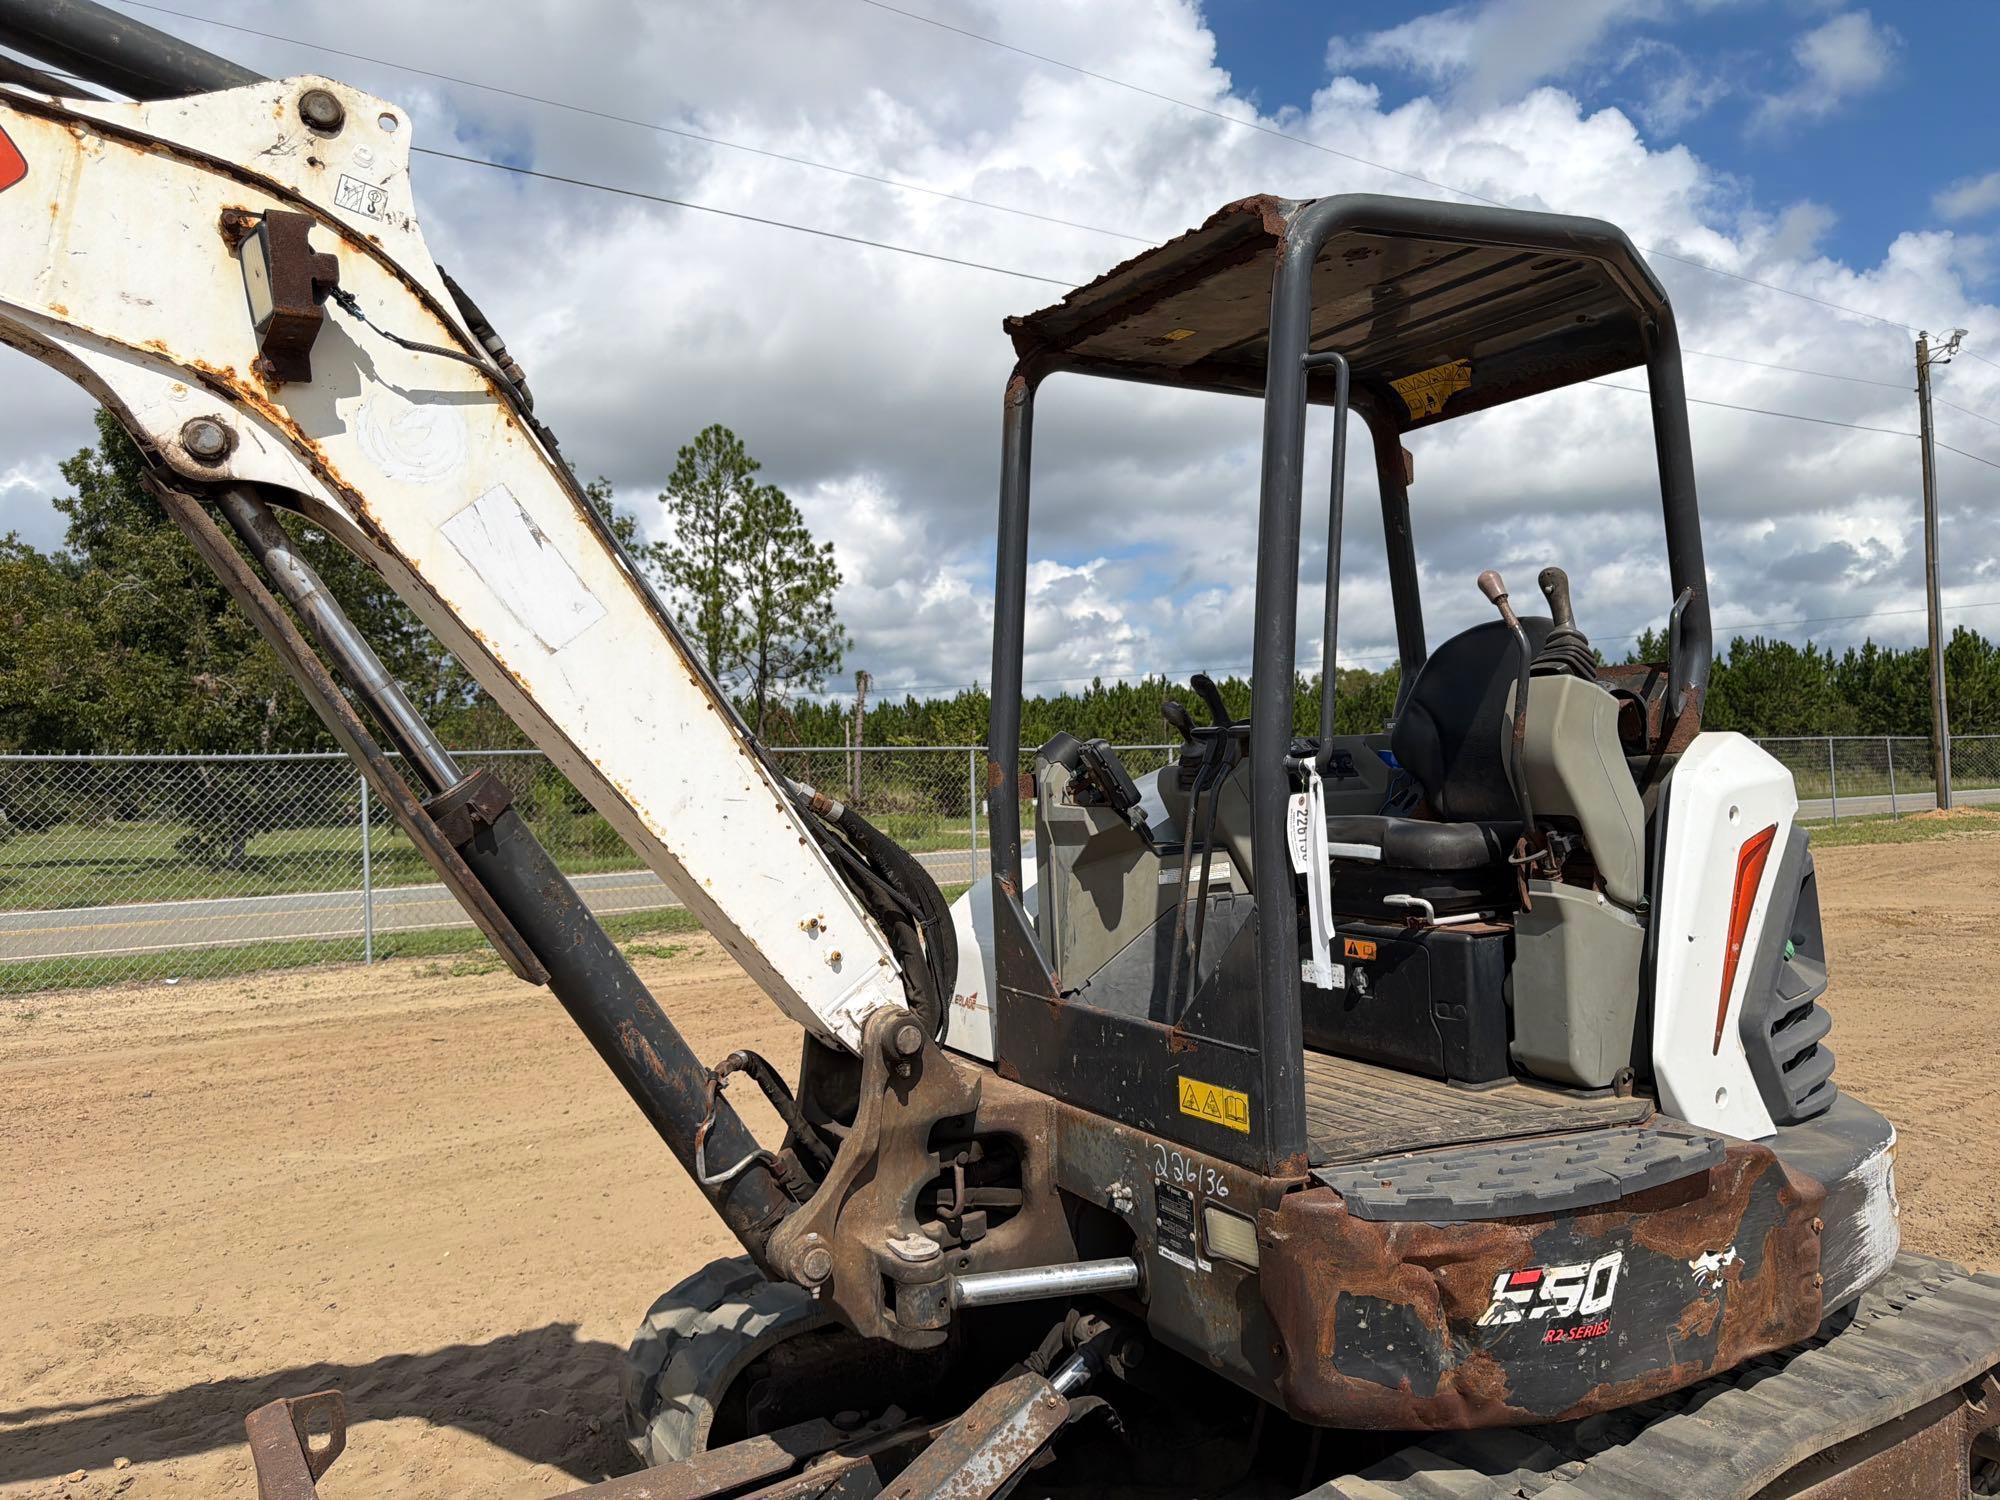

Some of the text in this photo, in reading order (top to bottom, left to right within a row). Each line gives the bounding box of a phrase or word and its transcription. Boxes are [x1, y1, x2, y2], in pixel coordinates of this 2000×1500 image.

[1153, 1143, 1229, 1197] 226136
[1476, 1251, 1623, 1327] E50
[1543, 1318, 1610, 1343] R2 SERIES
